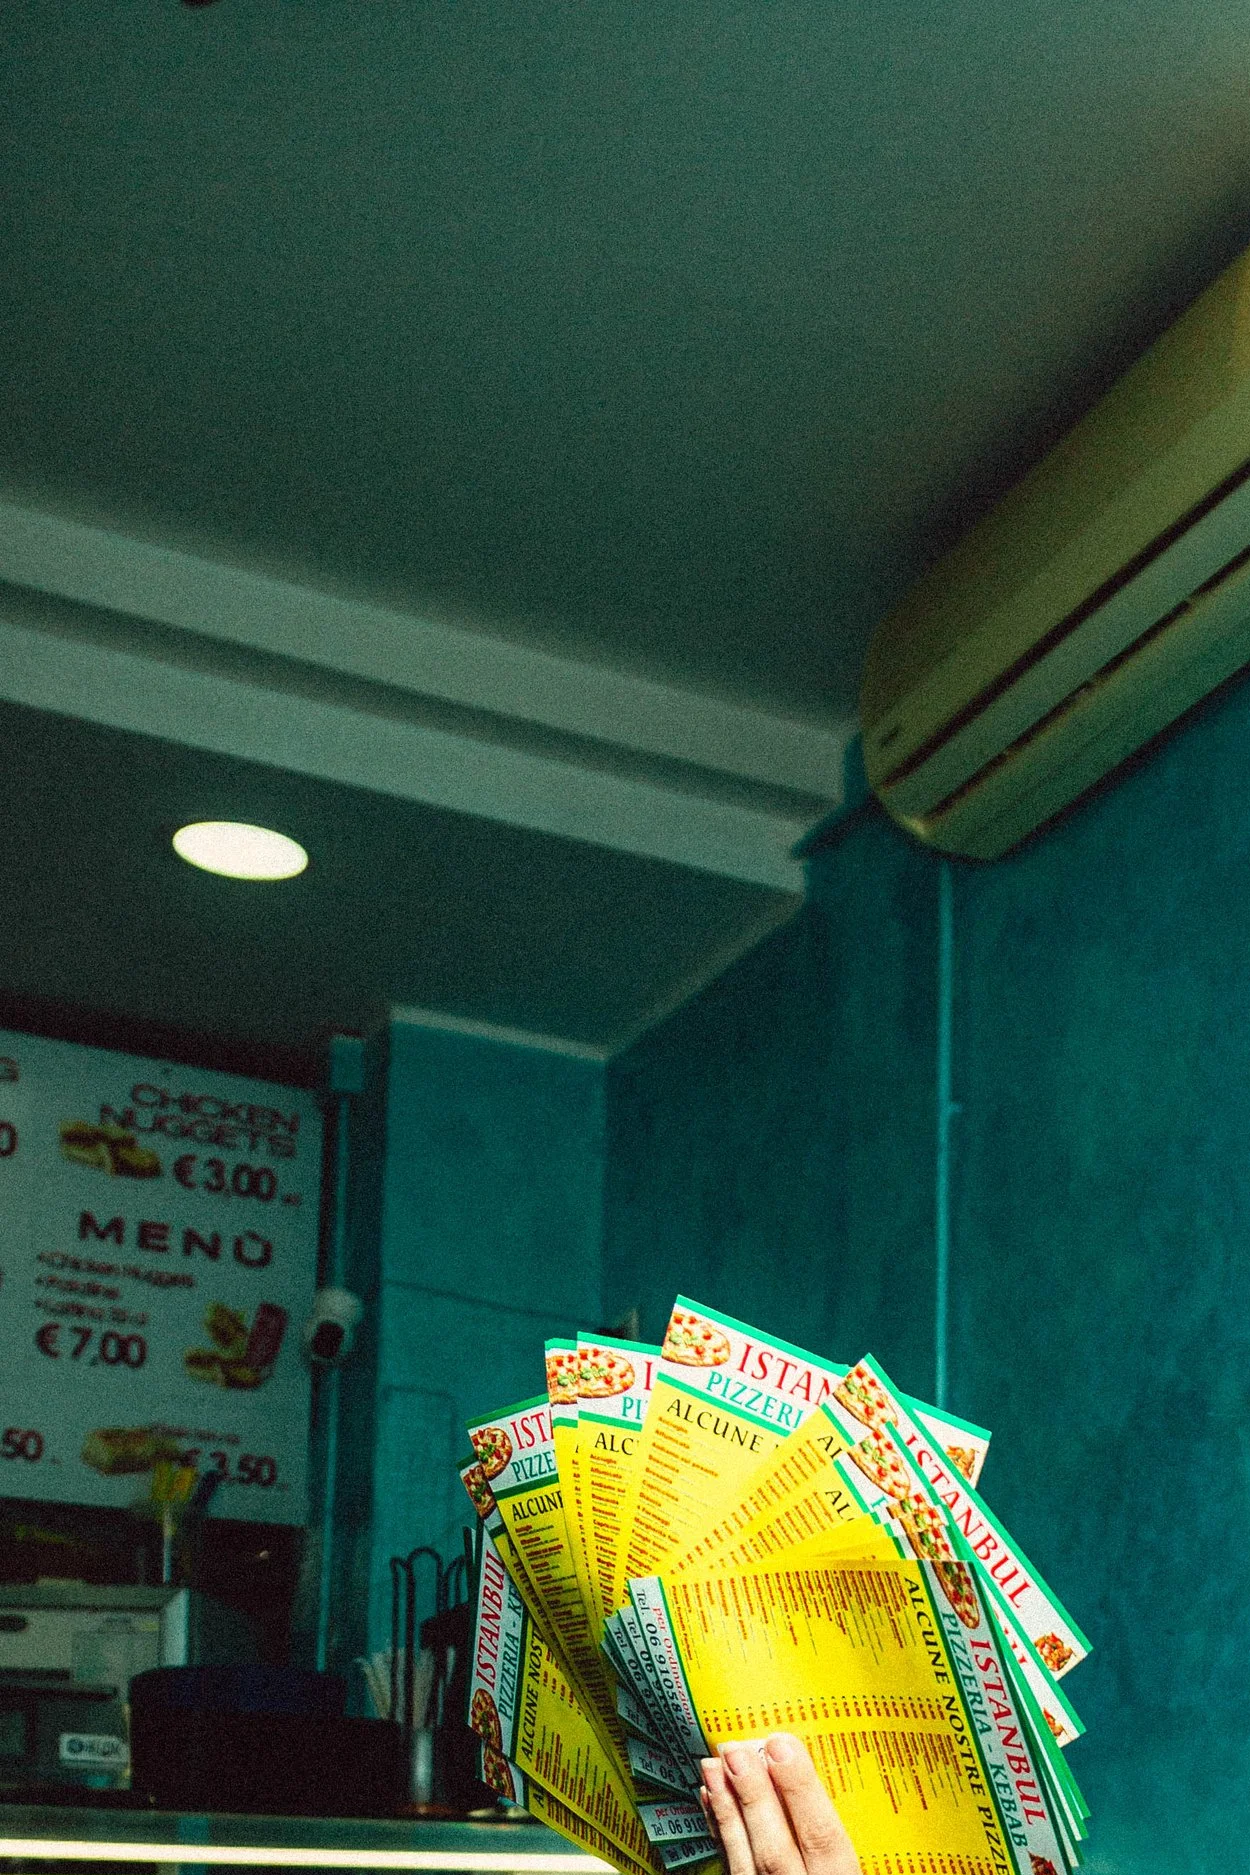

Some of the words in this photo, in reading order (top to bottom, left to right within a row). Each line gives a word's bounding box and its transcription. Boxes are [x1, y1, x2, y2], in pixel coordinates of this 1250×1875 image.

[98, 1104, 296, 1159] NUGGETS
[130, 1082, 301, 1133] CHICKEN
[667, 1398, 764, 1454] ALCUNE
[906, 1435, 1032, 1609] ISTANBUL
[652, 1607, 667, 1632] per
[499, 1631, 520, 1722] PIZZERIA
[636, 1589, 650, 1616] Tel.
[645, 1622, 661, 1647] 06
[654, 1654, 692, 1738] 9105870
[904, 1577, 951, 1685] ALCUNE
[942, 1695, 986, 1797] NOSTRE
[520, 1683, 540, 1763] ALCUNE
[941, 1612, 993, 1736] PIZZERIA
[990, 1763, 1028, 1848] KEBAB
[969, 1639, 1047, 1827] ISTANBUL
[667, 1820, 684, 1835] 06
